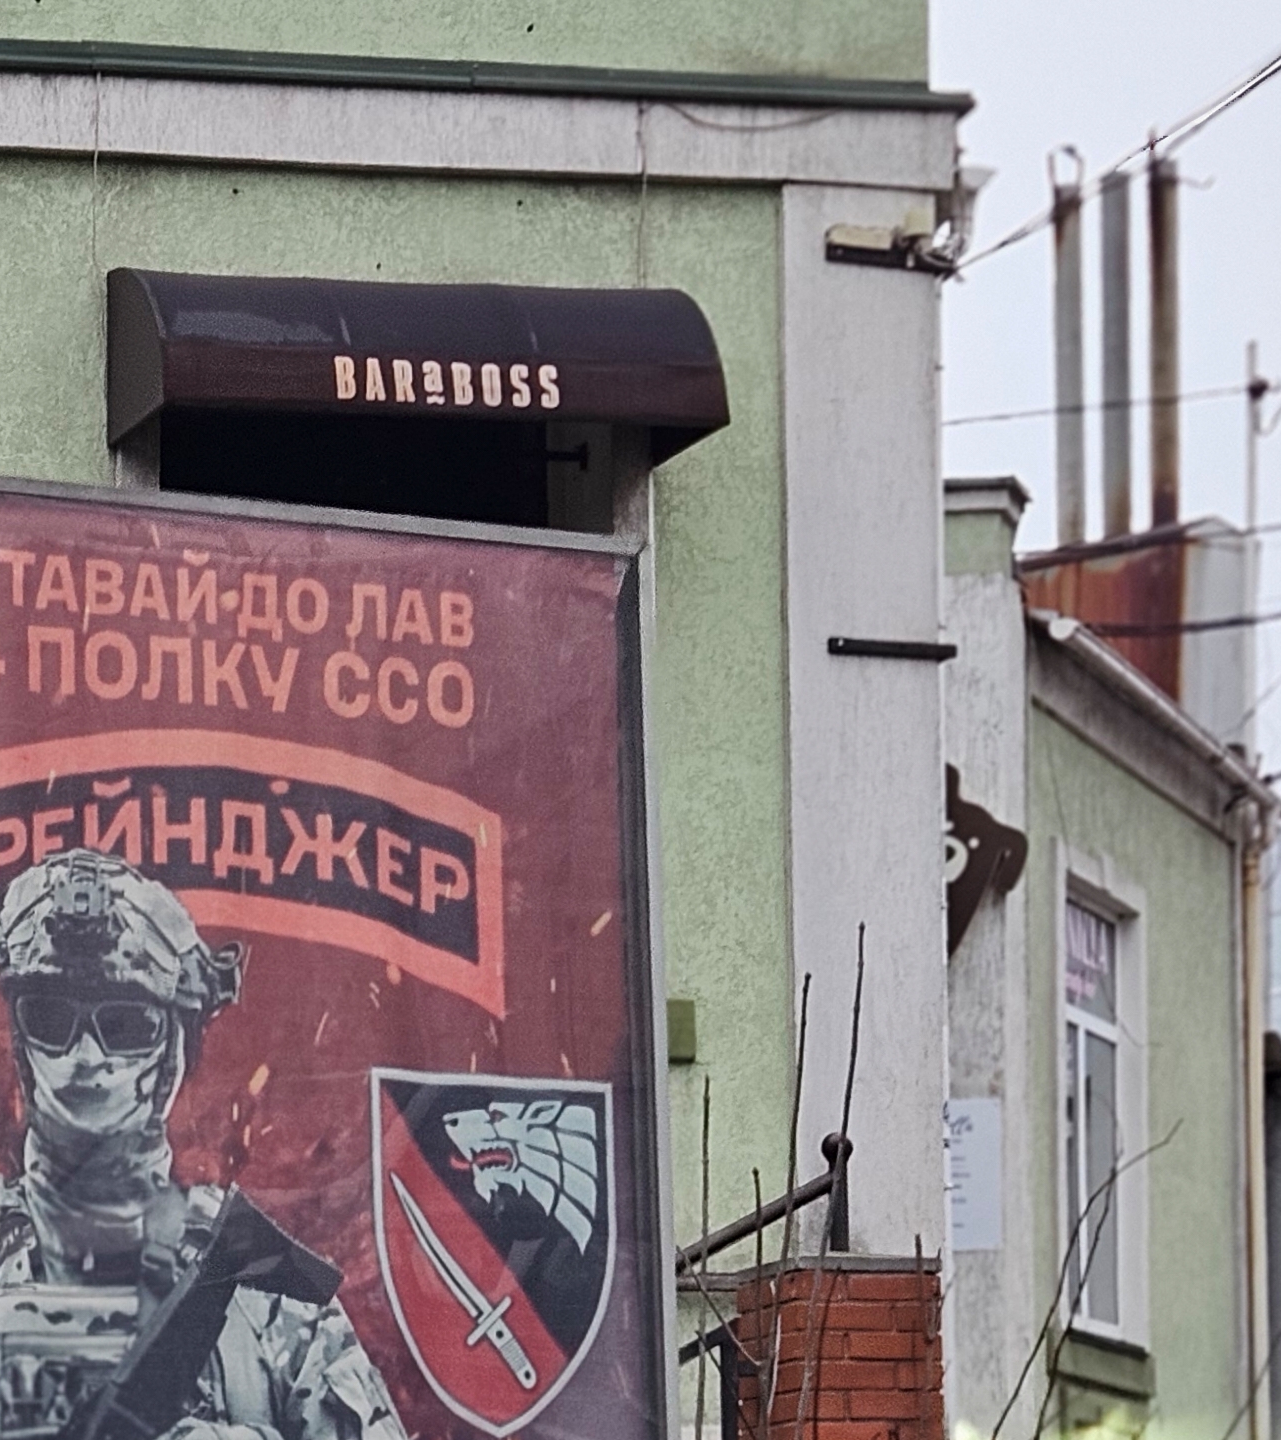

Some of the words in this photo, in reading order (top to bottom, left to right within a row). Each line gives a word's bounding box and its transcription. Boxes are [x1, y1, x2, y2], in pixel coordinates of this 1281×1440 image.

[239, 572, 330, 642] ДО
[345, 583, 475, 648] ЛАВ
[27, 623, 300, 713] ПОЛКУ
[322, 650, 475, 728] ССО
